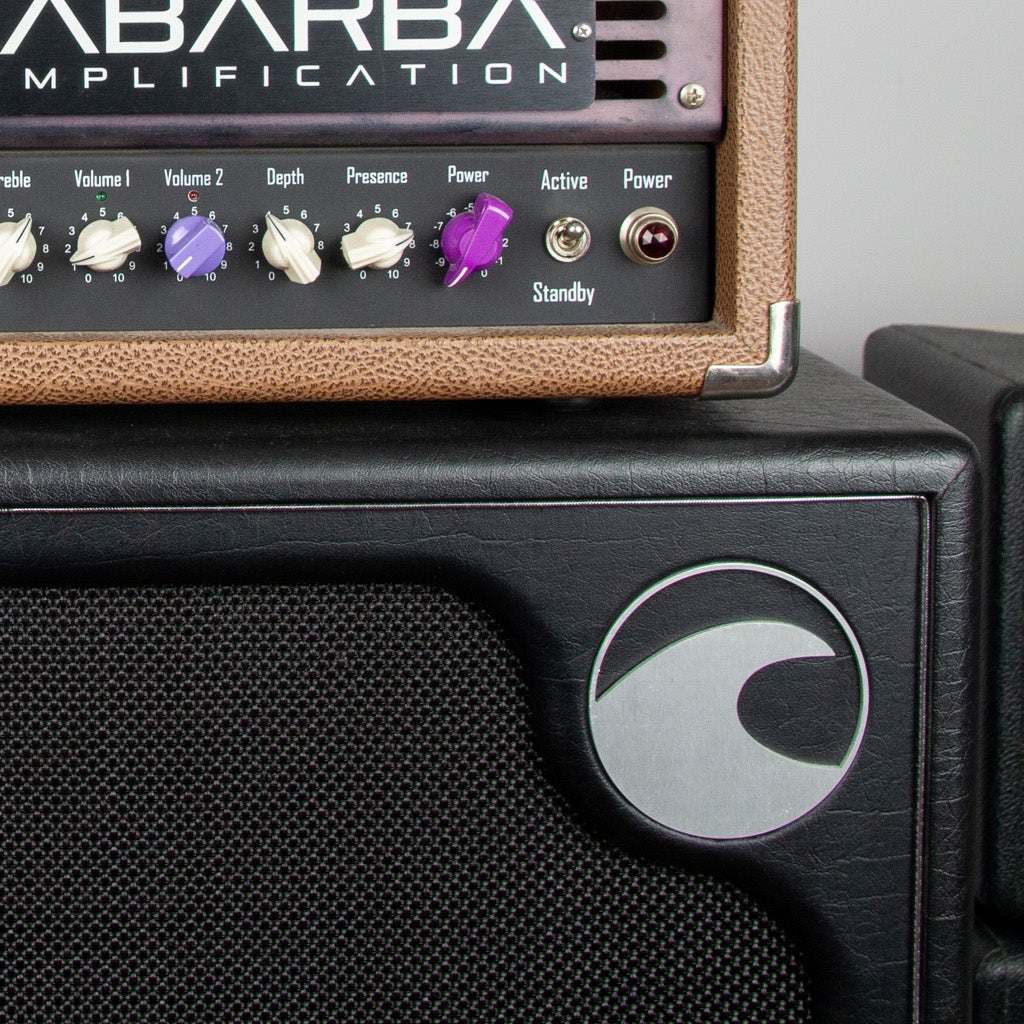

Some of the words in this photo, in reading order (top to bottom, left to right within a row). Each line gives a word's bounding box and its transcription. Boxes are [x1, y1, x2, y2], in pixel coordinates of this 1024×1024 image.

[164, 169, 212, 186] Volume
[216, 168, 223, 186] 2
[267, 167, 304, 188] Depth
[347, 167, 408, 184] Presence
[448, 165, 489, 183] Power
[623, 168, 672, 189] Power
[75, 170, 122, 188] Volume
[541, 169, 588, 190] Active
[8, 208, 14, 217] 5
[100, 208, 106, 216] 5
[283, 206, 289, 214] 5
[375, 204, 381, 213] 5
[392, 209, 399, 217] 6
[446, 208, 456, 217] -6
[81, 213, 88, 221] 4
[301, 210, 307, 219] 6
[357, 210, 363, 218] 4
[69, 226, 75, 235] 3
[253, 225, 259, 233] 3
[314, 224, 320, 232] 7
[344, 223, 350, 232] 3
[433, 222, 443, 230] -7
[39, 227, 45, 235] 7
[43, 244, 49, 253] 8
[65, 244, 71, 253] 2
[248, 242, 255, 251] 2
[318, 241, 324, 250] 8
[429, 240, 439, 248] -8
[129, 261, 136, 270] 9
[164, 262, 168, 270] 1
[255, 261, 259, 269] 1
[404, 258, 410, 266] 9
[436, 258, 445, 266] -9
[37, 263, 44, 271] 9
[21, 274, 33, 283] 10
[85, 274, 91, 283] 0
[113, 274, 124, 282] 10
[268, 272, 275, 281] 0
[360, 270, 366, 279] 0
[387, 270, 399, 278] 10
[533, 282, 595, 305] Standby
